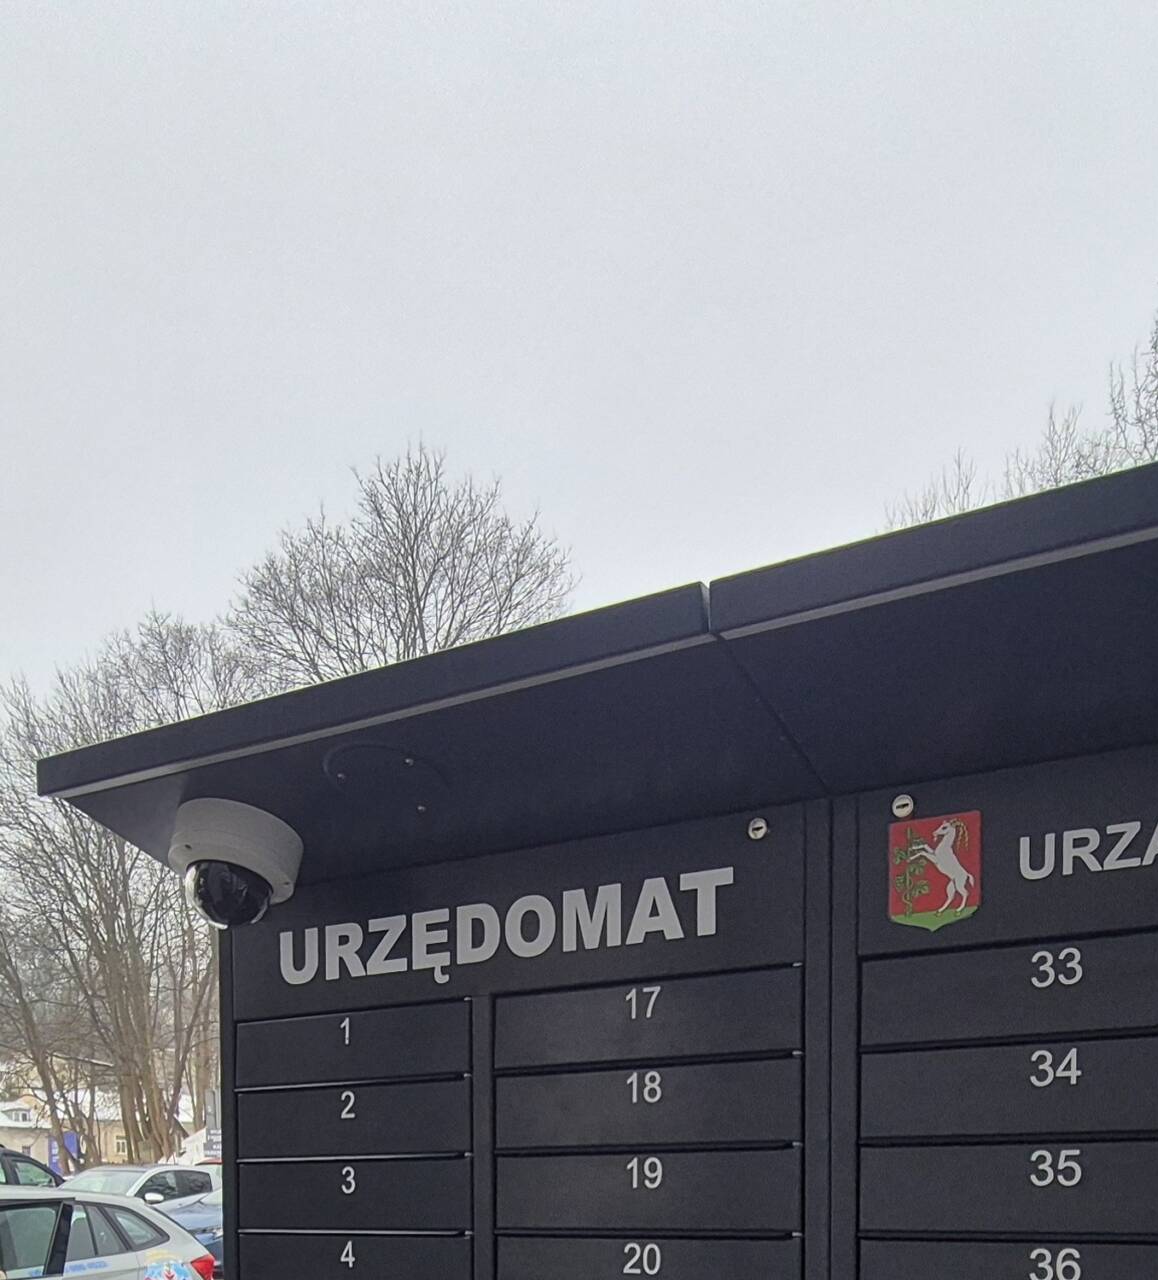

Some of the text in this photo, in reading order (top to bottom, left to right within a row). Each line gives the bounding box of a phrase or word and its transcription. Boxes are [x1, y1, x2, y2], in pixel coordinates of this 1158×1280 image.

[279, 866, 734, 985] URZĘDOMAT
[1031, 947, 1083, 988] 33
[625, 985, 661, 1020] 17
[340, 1017, 350, 1045] 1
[1030, 1047, 1082, 1087] 34
[626, 1070, 662, 1103] 18
[340, 1090, 356, 1119] 2
[341, 1166, 356, 1194] 3
[626, 1156, 663, 1189] 19
[1030, 1149, 1082, 1187] 35
[340, 1240, 356, 1268] 4
[622, 1242, 661, 1275] 20
